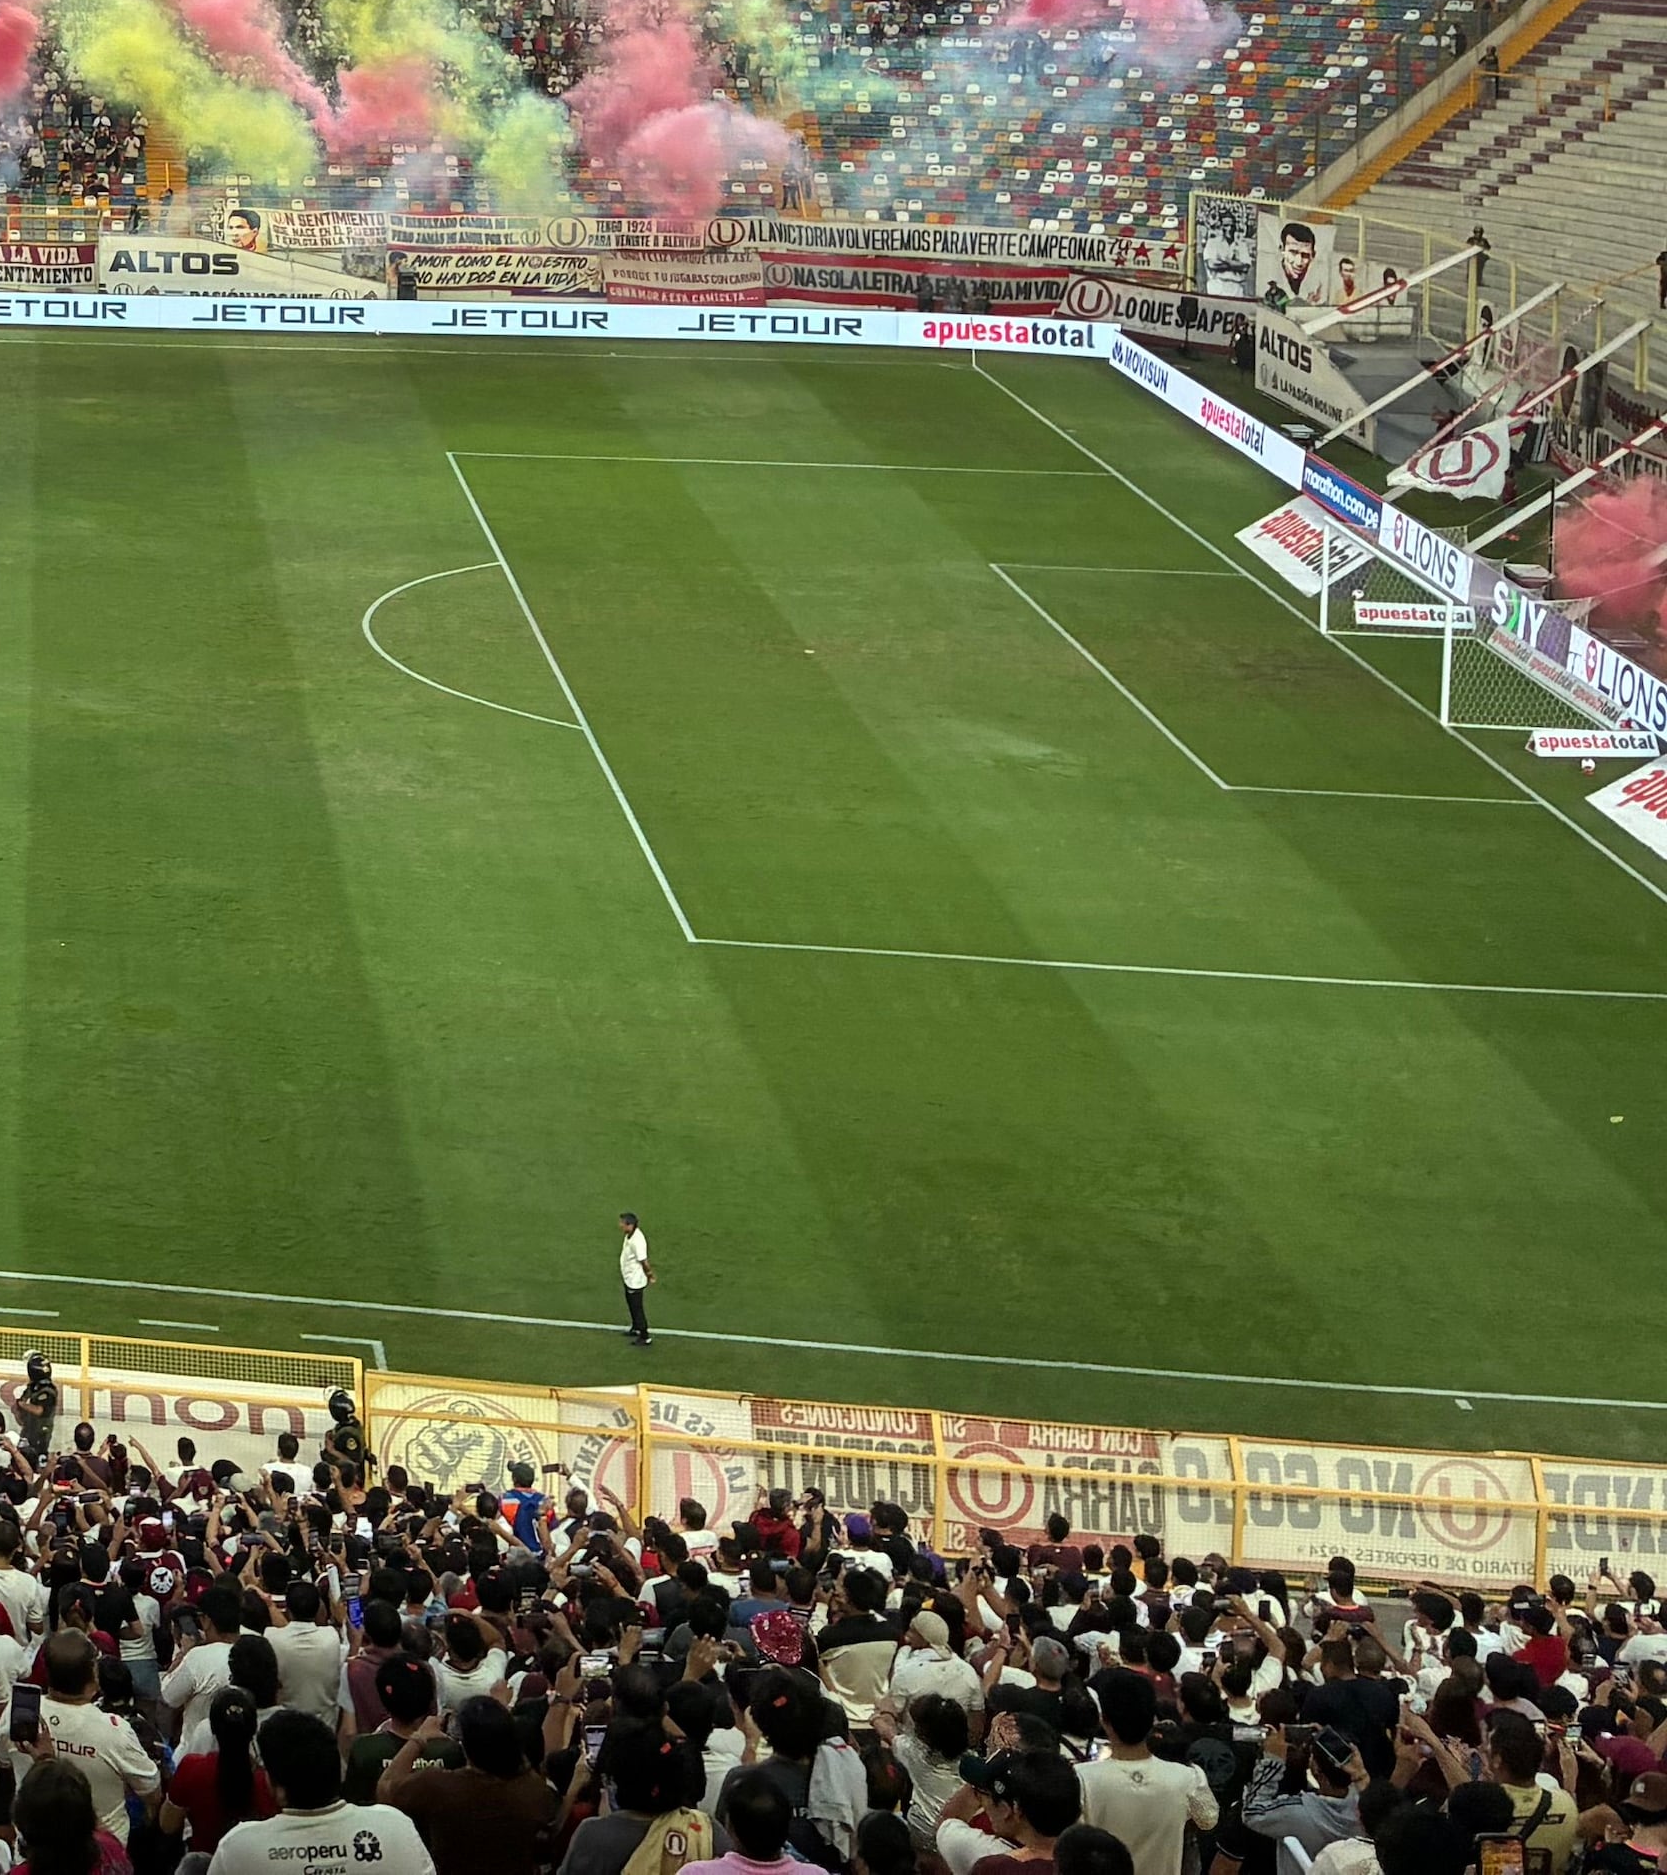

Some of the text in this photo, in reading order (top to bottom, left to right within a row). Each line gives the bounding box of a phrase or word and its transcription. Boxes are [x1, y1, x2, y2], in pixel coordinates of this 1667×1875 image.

[298, 211, 385, 227] SENTIMIENTO
[596, 220, 652, 233] TENGO 1924
[9, 244, 32, 264] LA
[36, 245, 80, 265] VIDA
[779, 226, 835, 249] VICTORIA
[835, 227, 931, 253] VOLVEREMOS
[932, 231, 971, 255] PARA
[969, 233, 1017, 257] VERTE
[1019, 235, 1106, 262] CAMPEONAR
[108, 250, 240, 275] ALTOS
[410, 256, 452, 269] AMOR
[455, 255, 491, 268] COMO
[495, 255, 512, 268] EL
[436, 271, 465, 285] HAY
[467, 271, 495, 284] DOS
[499, 270, 520, 284] EN
[523, 271, 541, 285] LA
[544, 271, 578, 286] VIDA
[613, 269, 651, 283] PORQUE
[819, 270, 863, 290] SOLA
[864, 272, 916, 293] LETRA
[1033, 280, 1066, 302] VIDA
[192, 304, 365, 325] JETOUR
[431, 308, 609, 330] JETOUR
[1113, 293, 1172, 326] LO QUE
[678, 313, 864, 337] JETOUR
[923, 317, 1096, 349] apuestatotal
[1259, 325, 1313, 374] ALTOS
[1123, 345, 1169, 394] MOVISUN
[1200, 396, 1266, 457] apuestatotal
[1303, 468, 1380, 528] marathon.com.pe
[1253, 509, 1364, 577] apuestatotal
[1402, 519, 1459, 590] LIONS
[1358, 605, 1473, 623] apuestatotal
[1597, 647, 1667, 732] LIONS
[1538, 733, 1656, 751] apuestatotal
[267, 1844, 348, 1863] aeroperu
